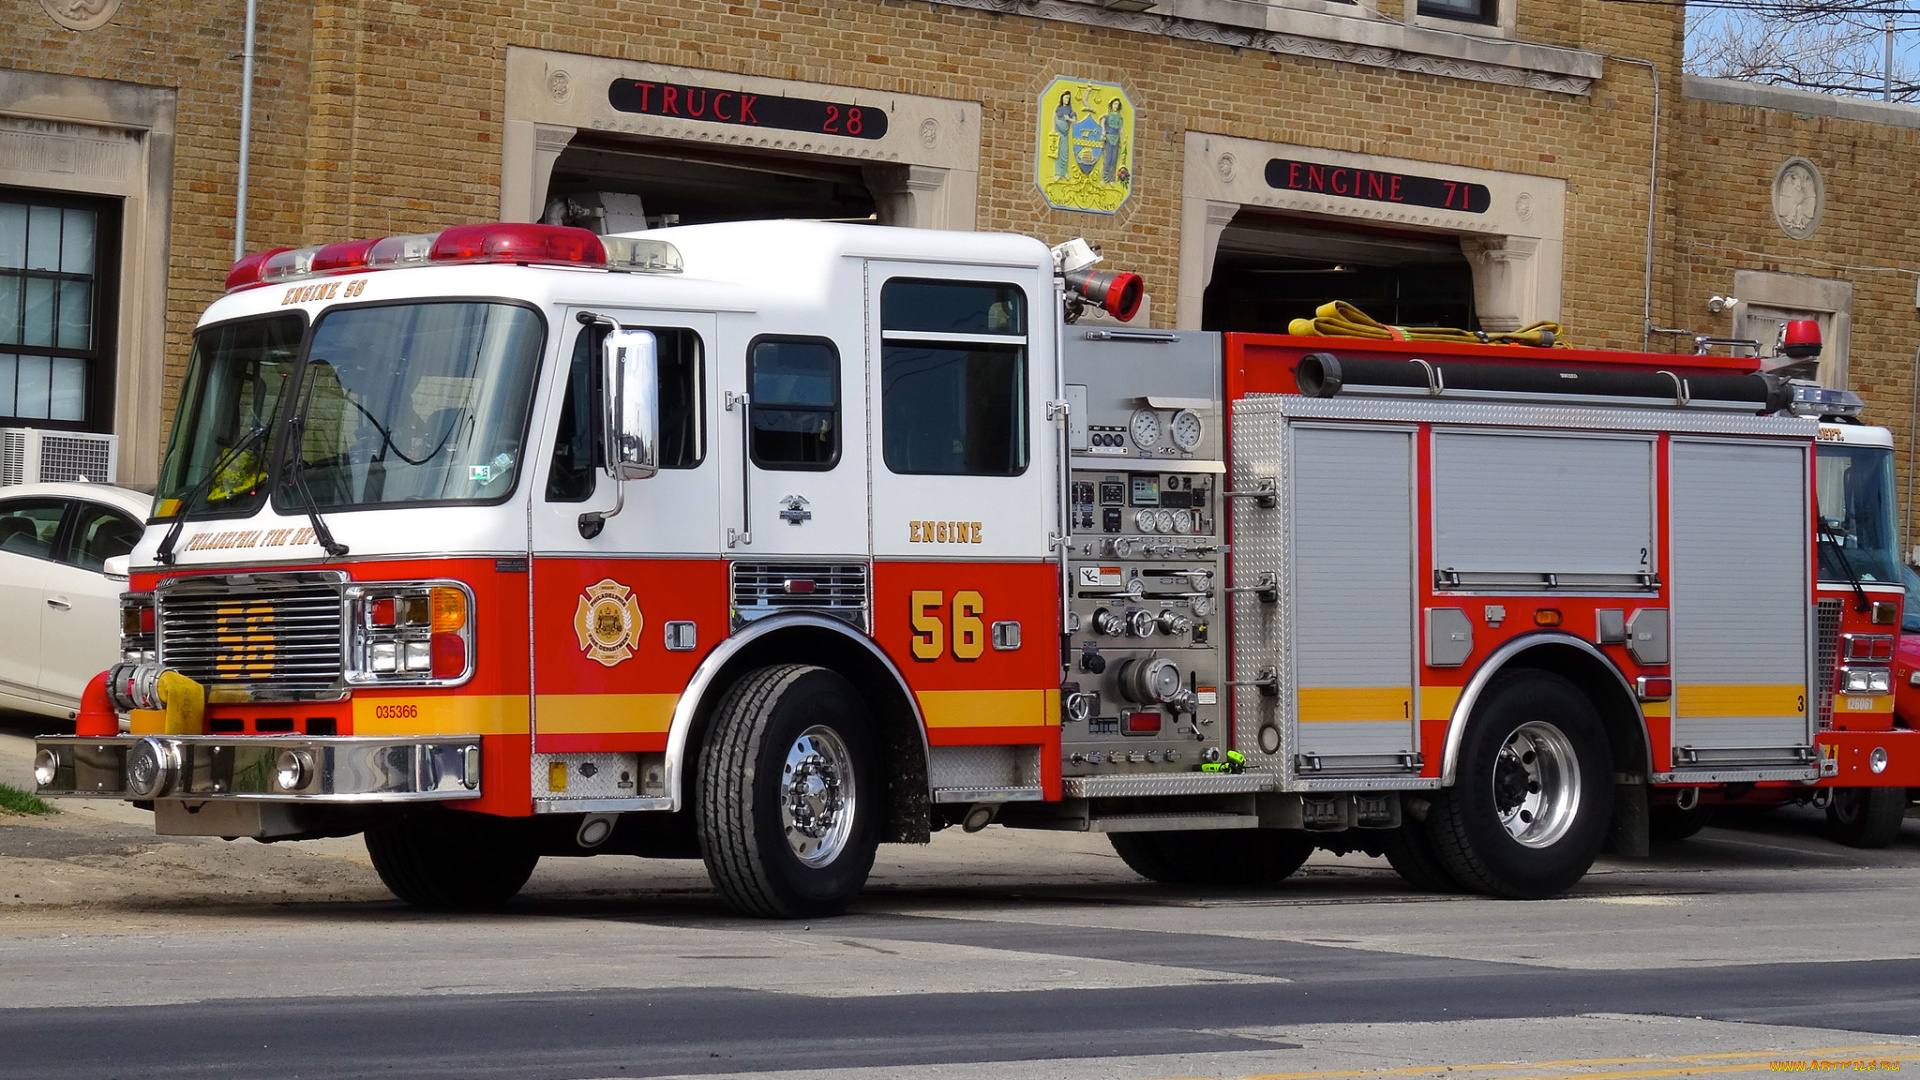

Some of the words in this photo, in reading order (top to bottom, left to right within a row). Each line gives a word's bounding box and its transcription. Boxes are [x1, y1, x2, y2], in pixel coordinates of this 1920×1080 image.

[634, 82, 758, 124] TRUCK
[822, 105, 863, 135] 28
[1288, 162, 1404, 201] ENGINE
[1443, 182, 1470, 210] 71
[281, 282, 342, 305] ENGINE
[344, 279, 368, 297] 56
[184, 529, 263, 552] PHILADELPHIA
[259, 527, 294, 547] FIRE
[909, 520, 983, 544] ENGINE
[1640, 547, 1648, 565] 2
[590, 592, 627, 608] PHILADELPHIA
[909, 590, 984, 662] 56
[216, 601, 276, 679] 56
[588, 632, 599, 648] FIRE
[598, 632, 631, 652] DEPARTMENT
[375, 704, 418, 719] 035366
[1403, 700, 1409, 719] 1
[1797, 695, 1804, 713] 3
